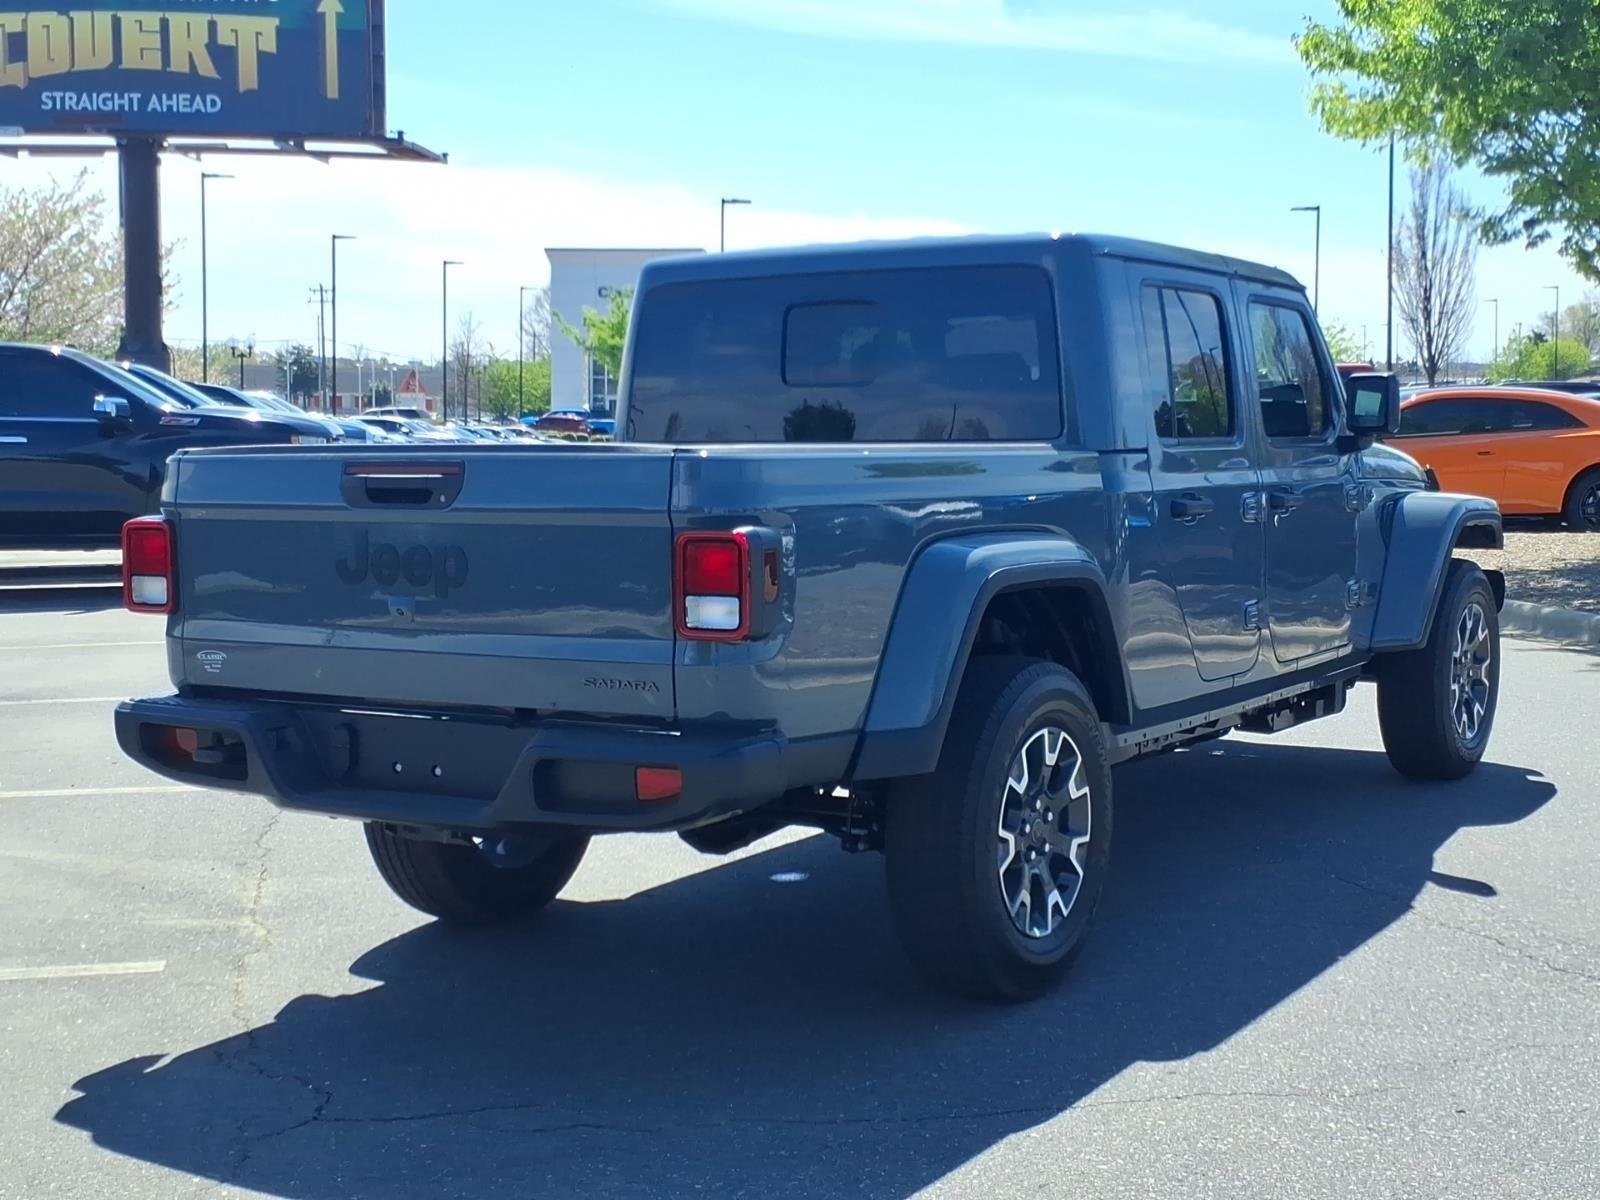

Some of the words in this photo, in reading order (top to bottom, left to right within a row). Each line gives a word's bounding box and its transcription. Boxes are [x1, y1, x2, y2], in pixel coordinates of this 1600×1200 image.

[41, 91, 141, 111] STRAIGHT
[147, 93, 222, 113] AHEAD
[335, 527, 469, 599] Jeep
[198, 653, 226, 661] CLASSIC
[583, 677, 660, 692] SAHARA
